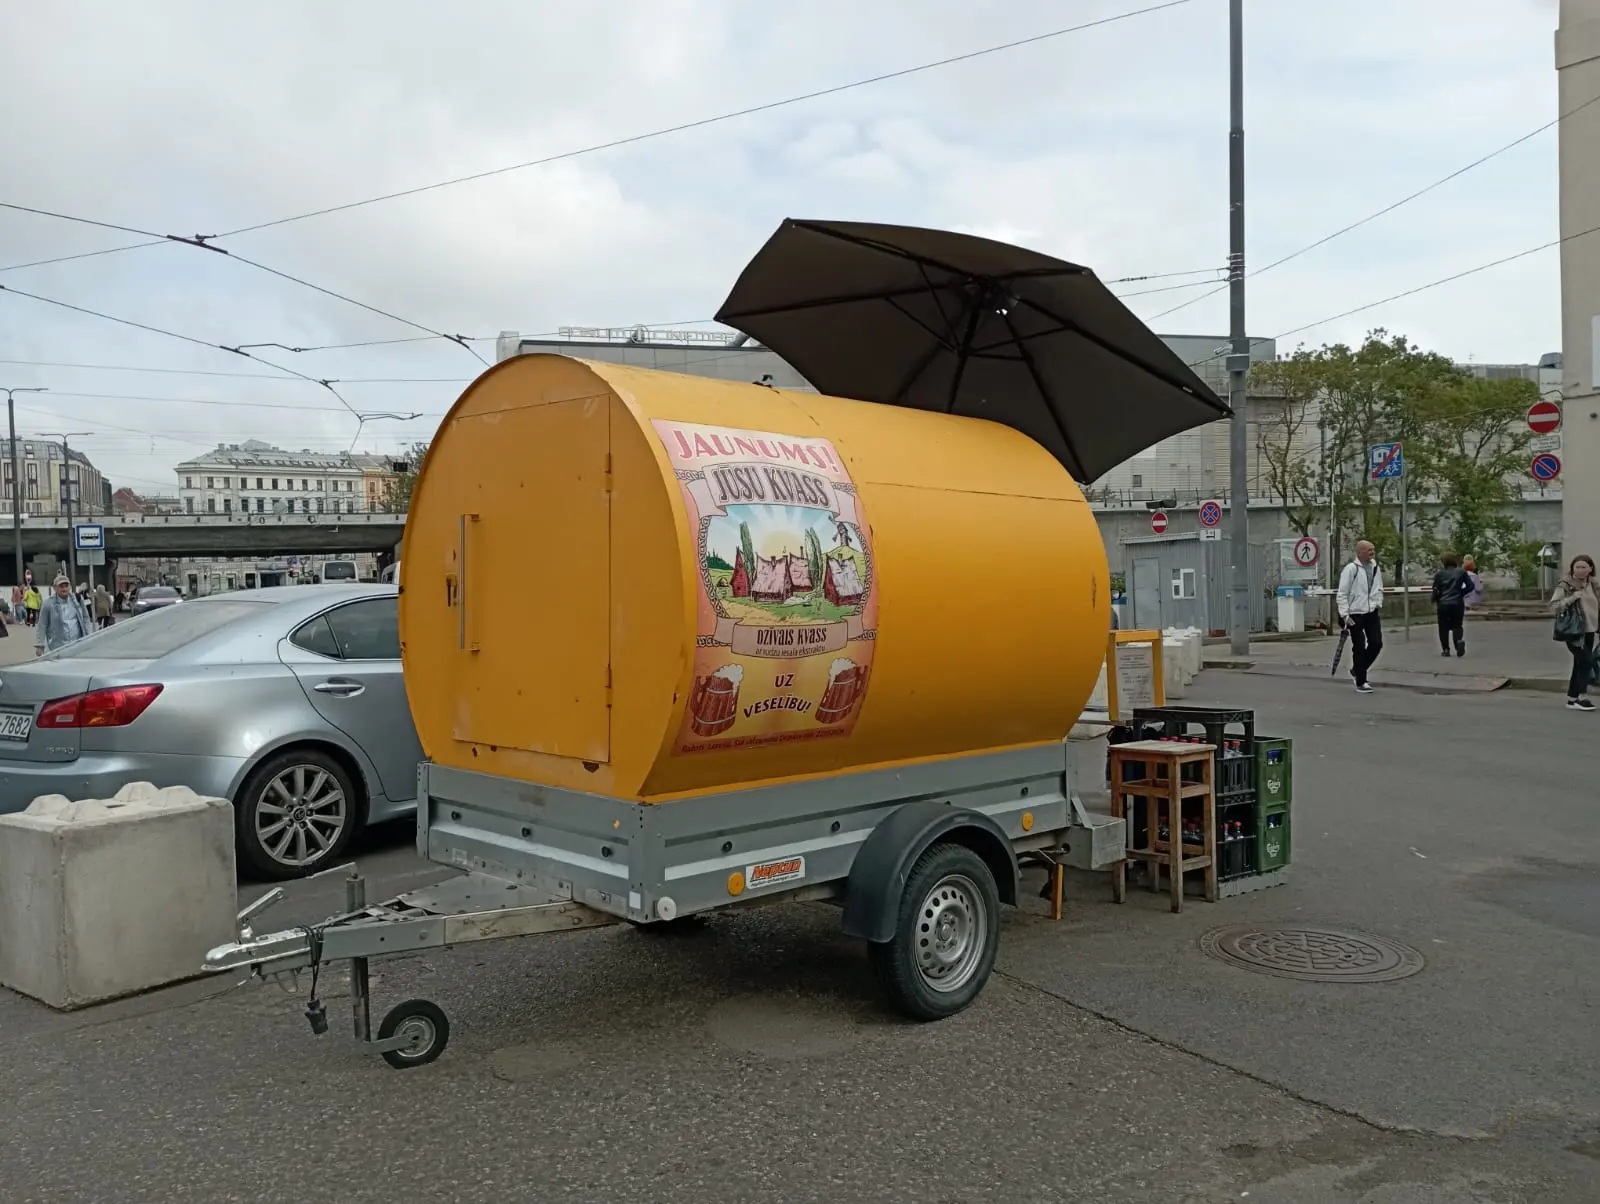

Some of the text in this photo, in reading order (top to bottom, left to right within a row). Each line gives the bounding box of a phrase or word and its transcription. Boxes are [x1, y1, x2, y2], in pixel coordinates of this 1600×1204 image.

[672, 429, 839, 473] JAUNUMS!
[763, 466, 831, 507] KVASS
[775, 673, 794, 687] UZ
[743, 694, 811, 718] VESELĪBU!
